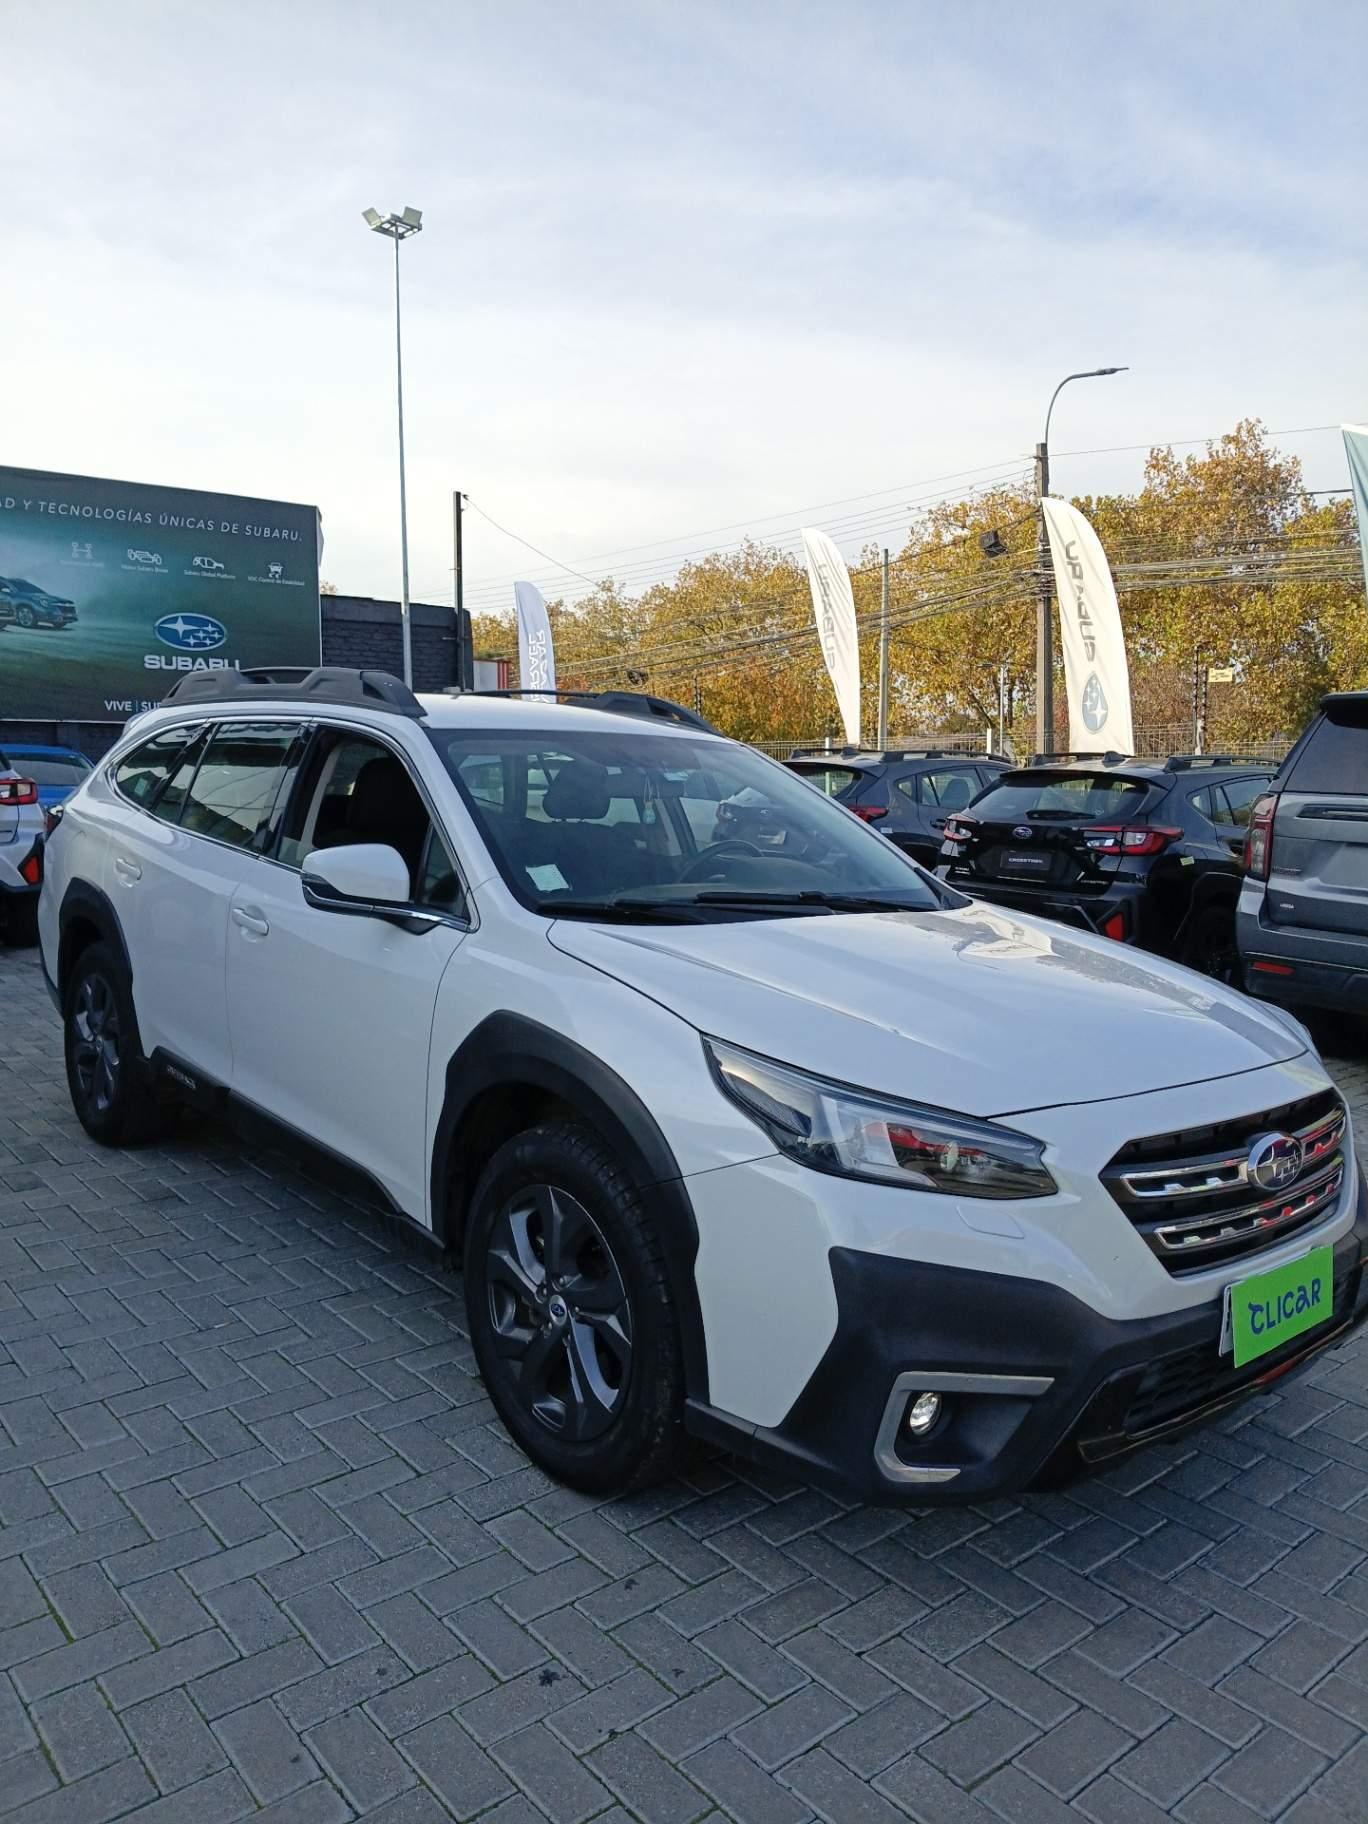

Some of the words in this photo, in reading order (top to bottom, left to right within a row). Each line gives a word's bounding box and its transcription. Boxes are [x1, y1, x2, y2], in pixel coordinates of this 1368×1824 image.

[0, 497, 15, 509] D
[23, 499, 32, 510] Y
[38, 500, 152, 524] TECNOLOGÍAS
[160, 512, 215, 531] ÚNICAS
[220, 522, 239, 534] DE
[245, 525, 302, 542] SUBARU.
[104, 700, 132, 712] VIVE
